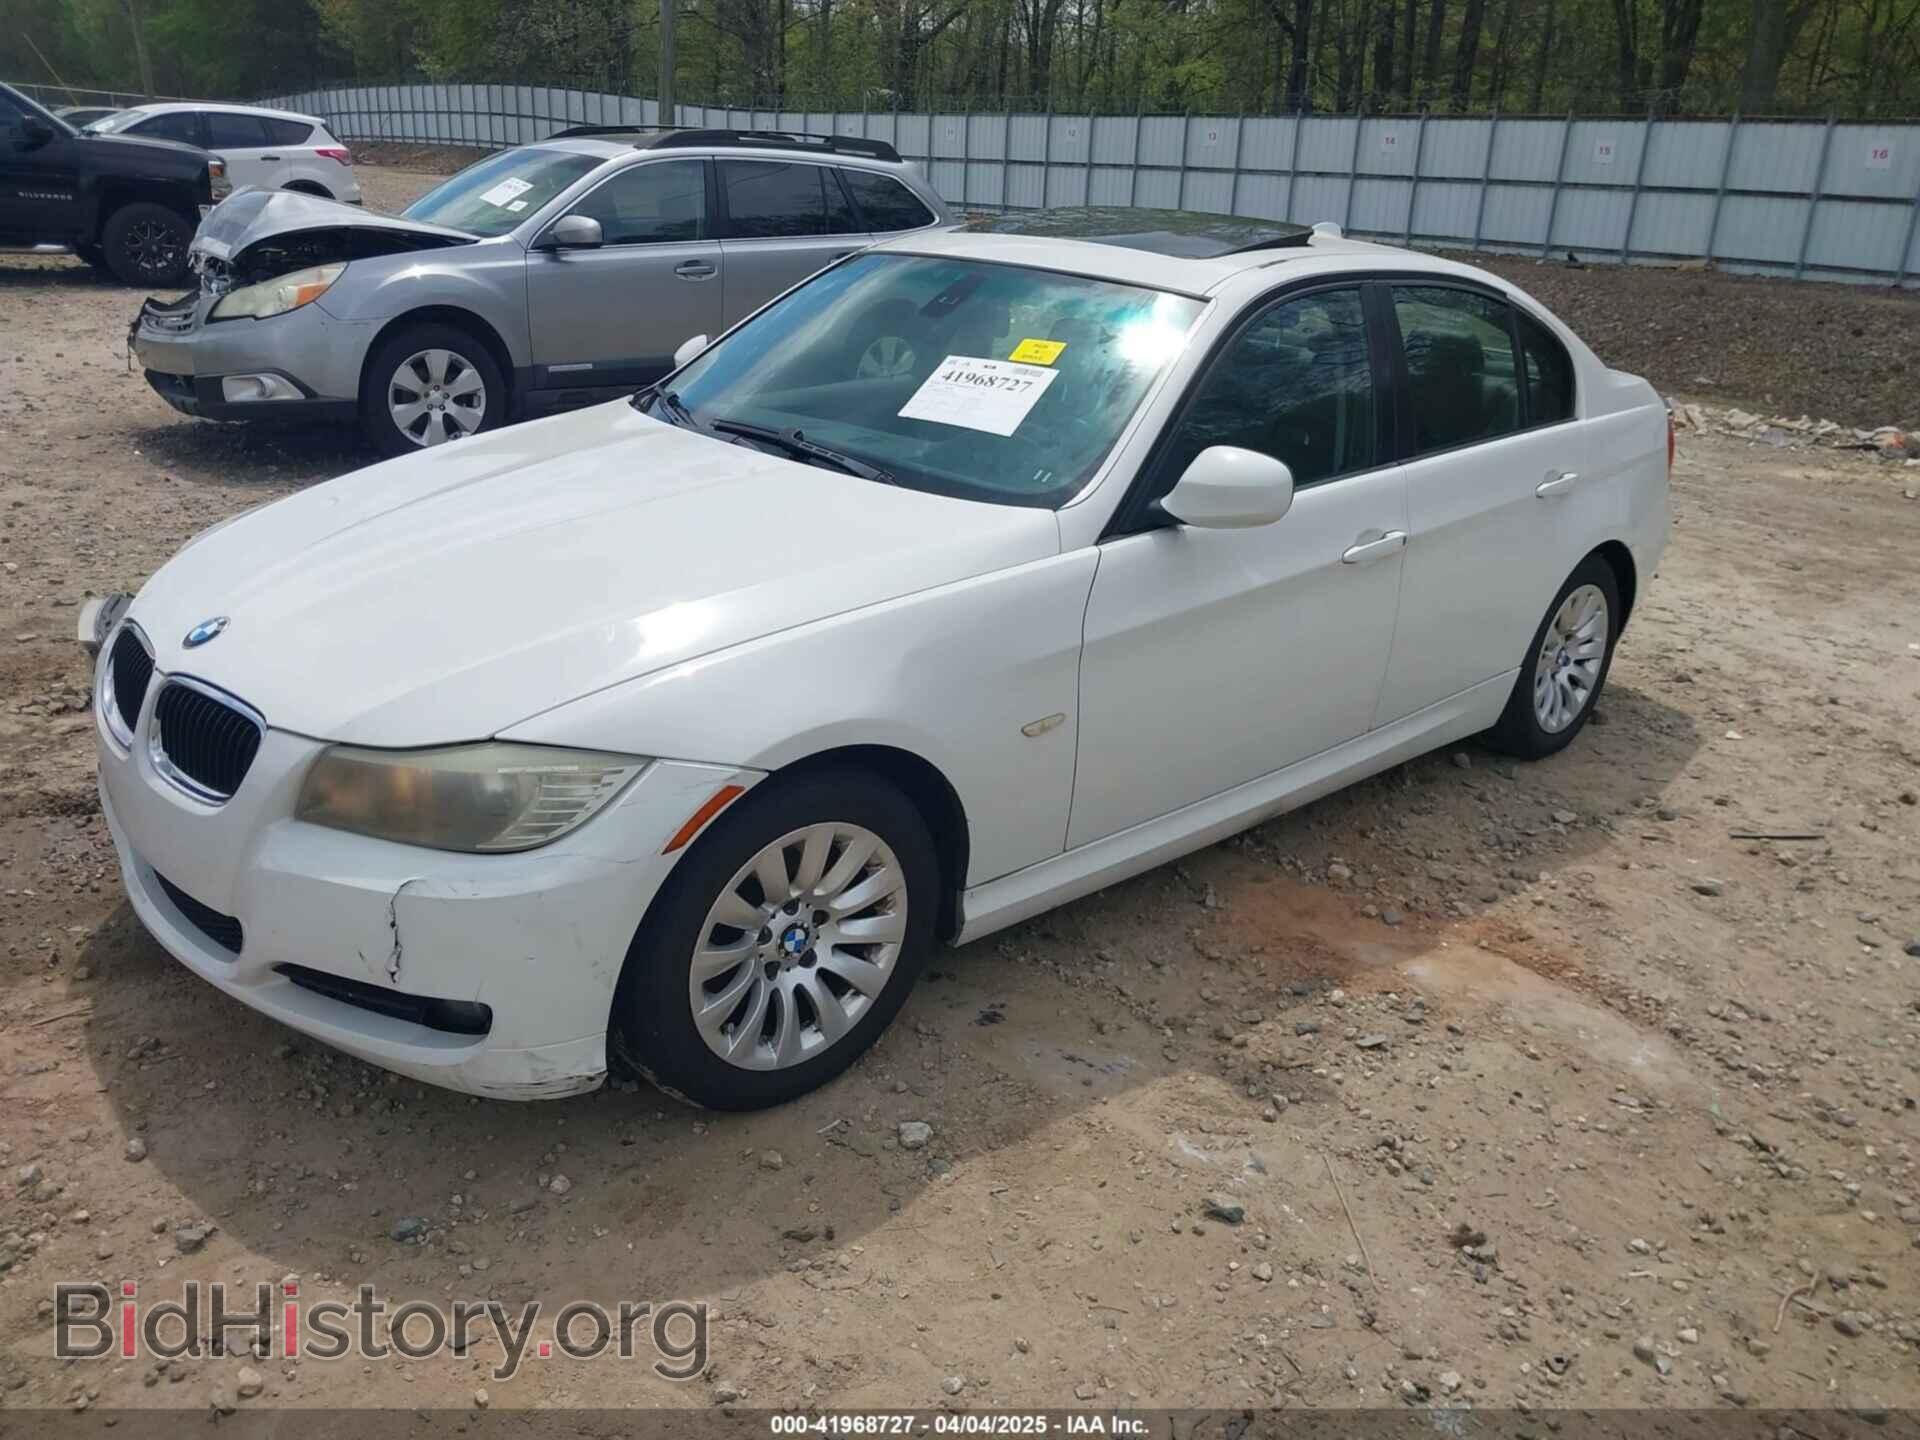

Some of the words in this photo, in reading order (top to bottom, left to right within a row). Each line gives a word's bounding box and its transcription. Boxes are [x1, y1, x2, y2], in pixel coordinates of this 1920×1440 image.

[1871, 148, 1889, 160] 16
[17, 191, 73, 201] SILVERADO
[943, 369, 1033, 393] 41968727
